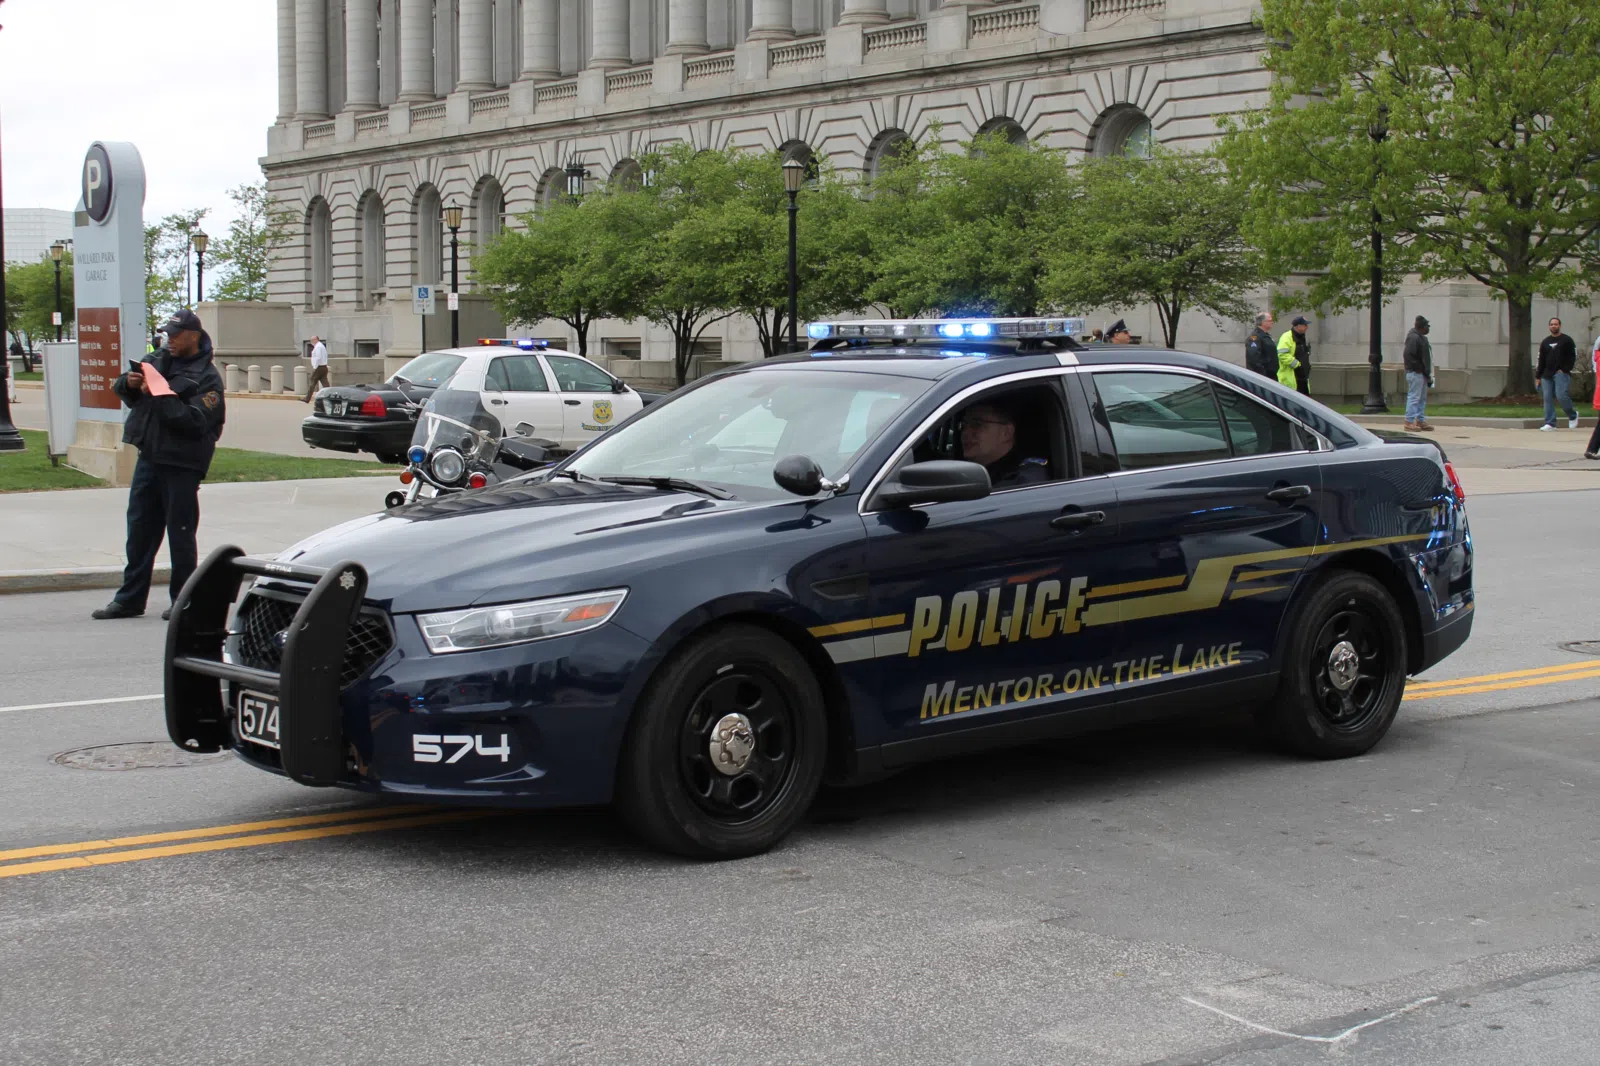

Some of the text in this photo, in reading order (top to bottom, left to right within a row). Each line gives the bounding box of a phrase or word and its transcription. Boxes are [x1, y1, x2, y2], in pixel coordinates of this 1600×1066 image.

[87, 159, 101, 208] P
[76, 252, 116, 264] WILLARD PARK
[85, 269, 107, 281] GARAGE
[908, 576, 1088, 657] POLICE
[243, 698, 280, 740] 574
[413, 734, 510, 763] 574
